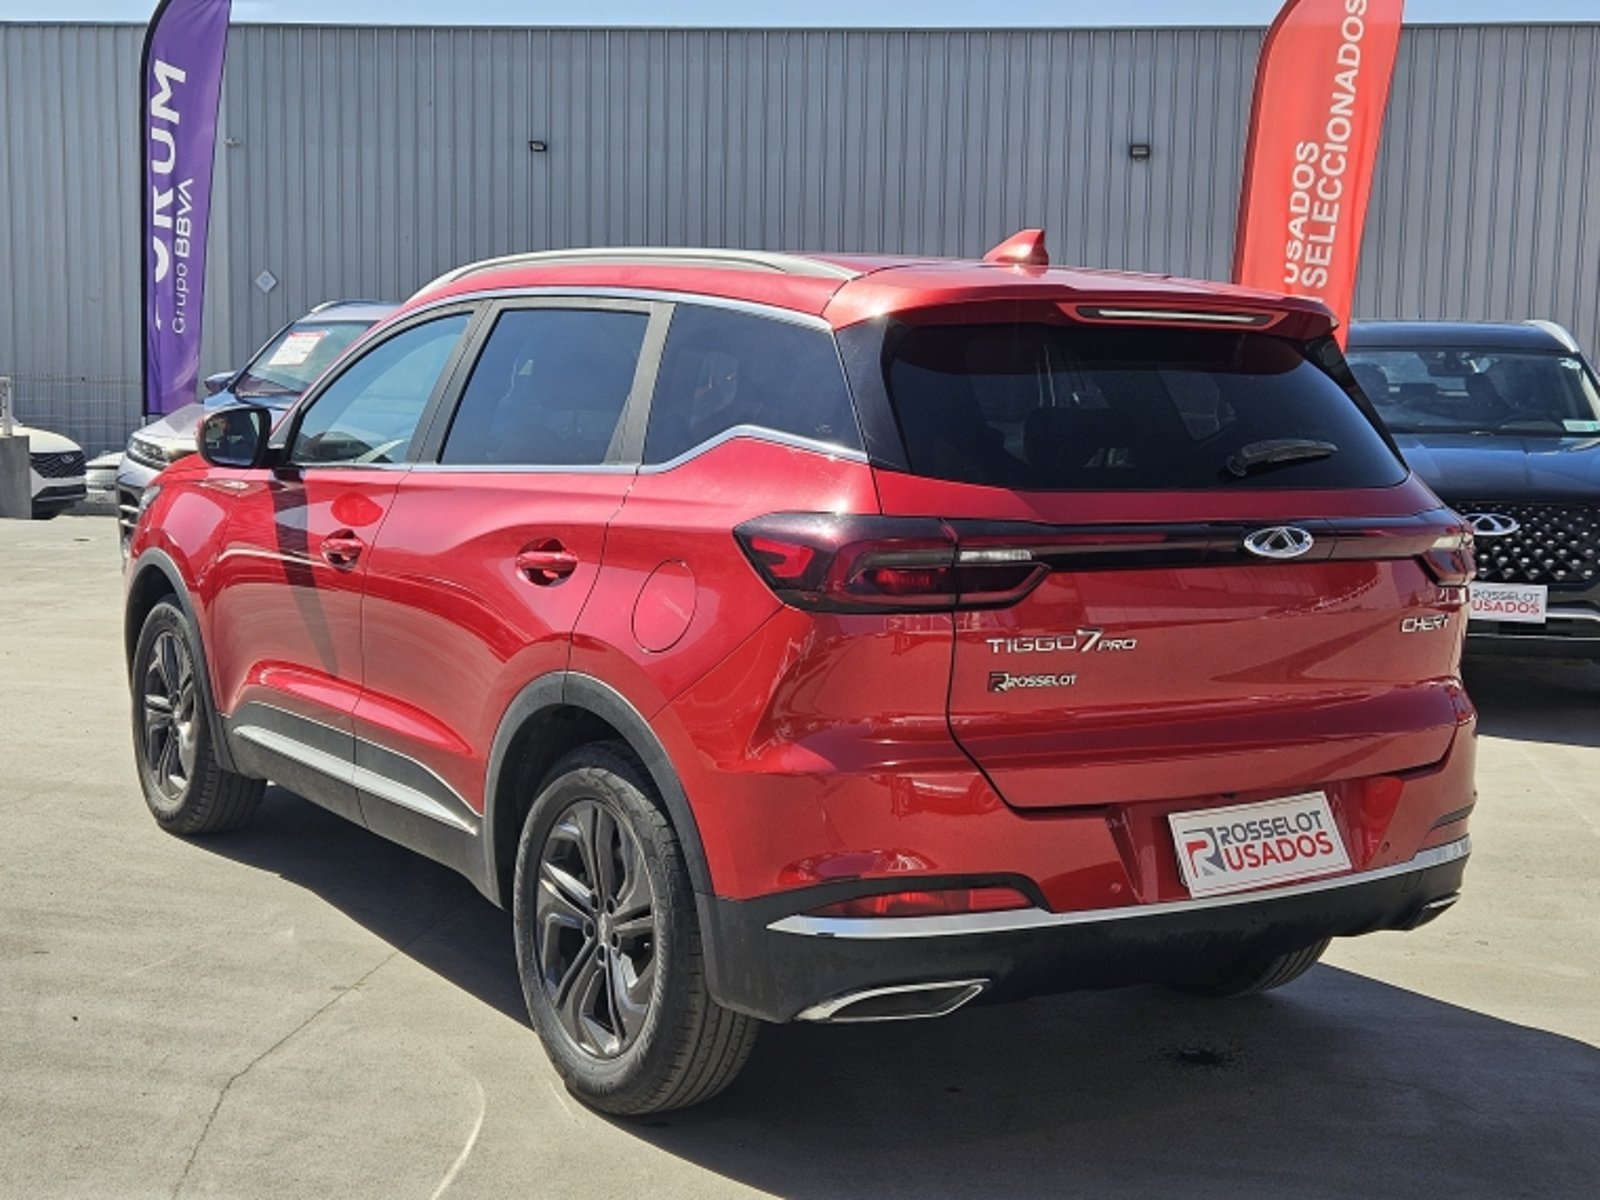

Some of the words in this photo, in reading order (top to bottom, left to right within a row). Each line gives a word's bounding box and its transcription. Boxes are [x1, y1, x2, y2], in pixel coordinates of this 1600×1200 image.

[1301, 0, 1367, 288] SELECCIONADOS
[174, 178, 194, 258] BBVA
[1283, 141, 1319, 284] USADOS
[172, 262, 190, 333] Grupo
[1471, 588, 1541, 602] ROSSELOT
[1472, 600, 1541, 615] USADOS
[1401, 615, 1449, 632] CHERY
[1216, 810, 1322, 847] ROSSELOT
[1223, 831, 1334, 872] USADOS
